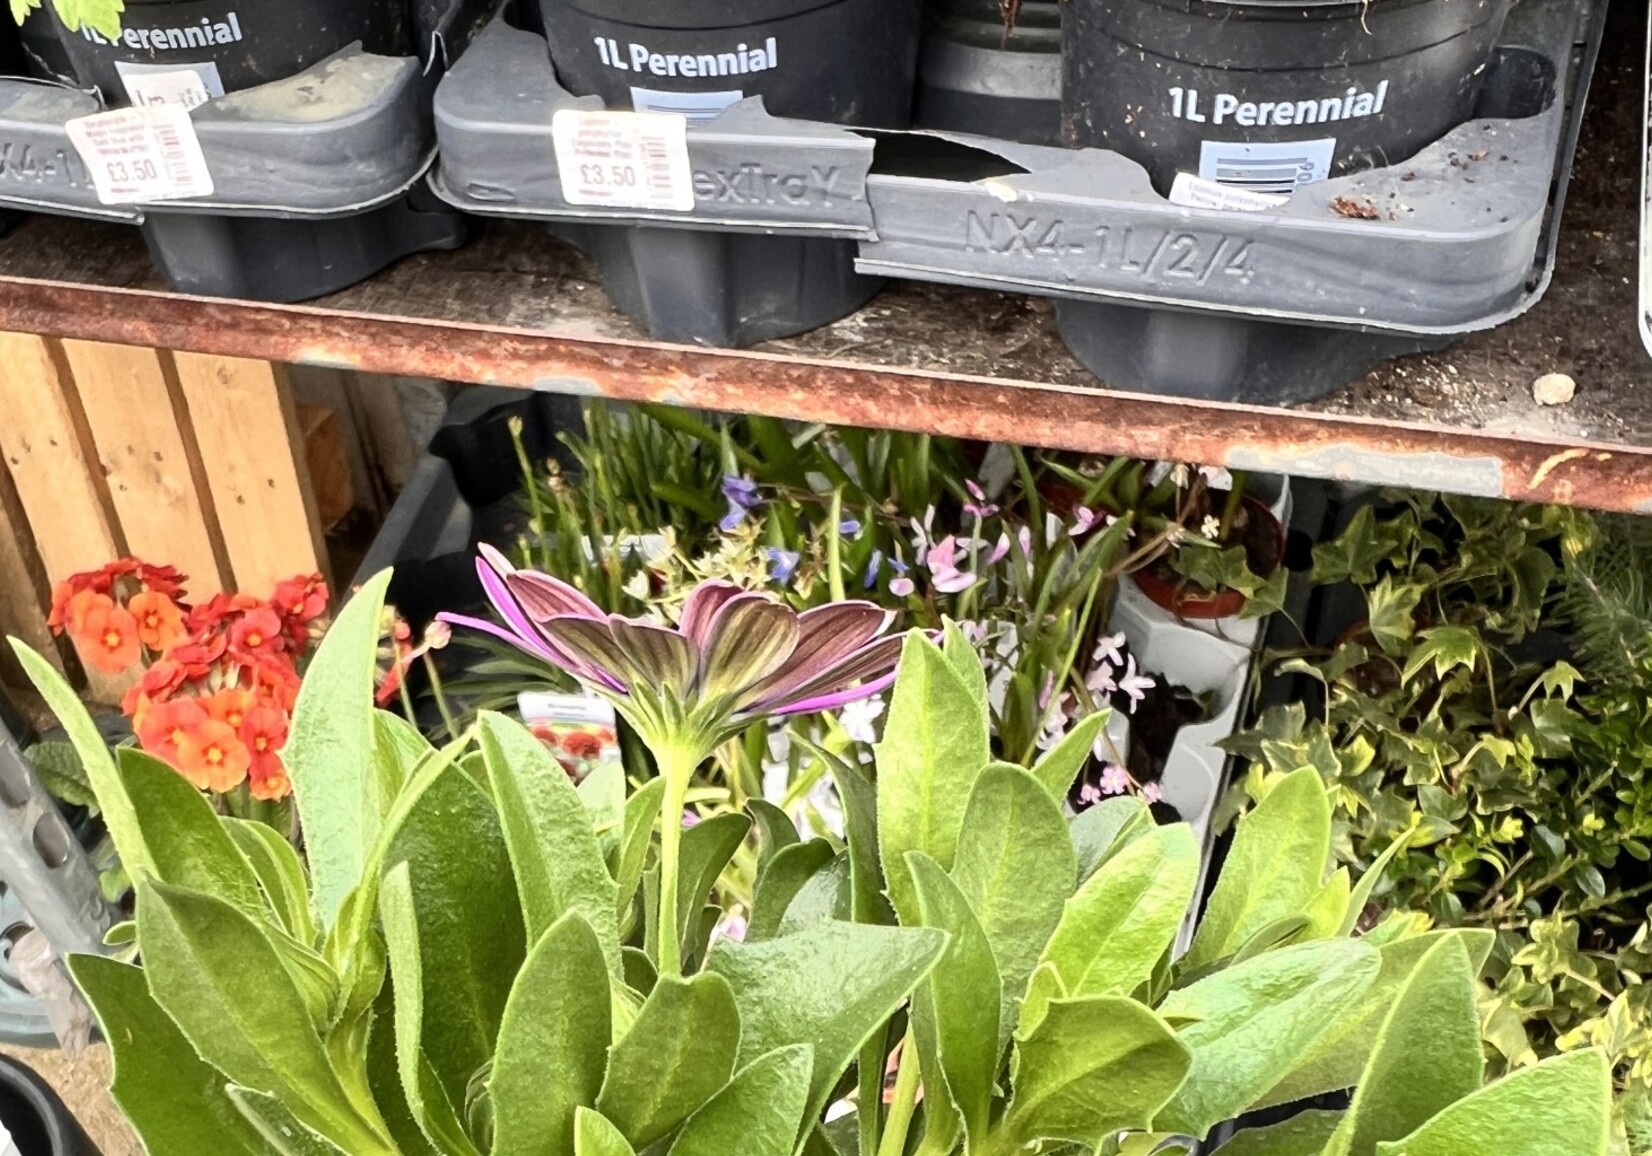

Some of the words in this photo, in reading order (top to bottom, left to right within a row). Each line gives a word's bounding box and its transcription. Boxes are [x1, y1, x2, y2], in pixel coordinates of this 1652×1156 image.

[110, 12, 243, 49] erennial
[594, 36, 628, 70] 1L
[629, 37, 777, 77] Perennial
[1168, 87, 1206, 122] 1L
[1213, 80, 1389, 126] Perennial
[106, 159, 157, 182] £3.50
[580, 164, 636, 187] £3.50
[966, 209, 1255, 286] NX4-1L/2/4
